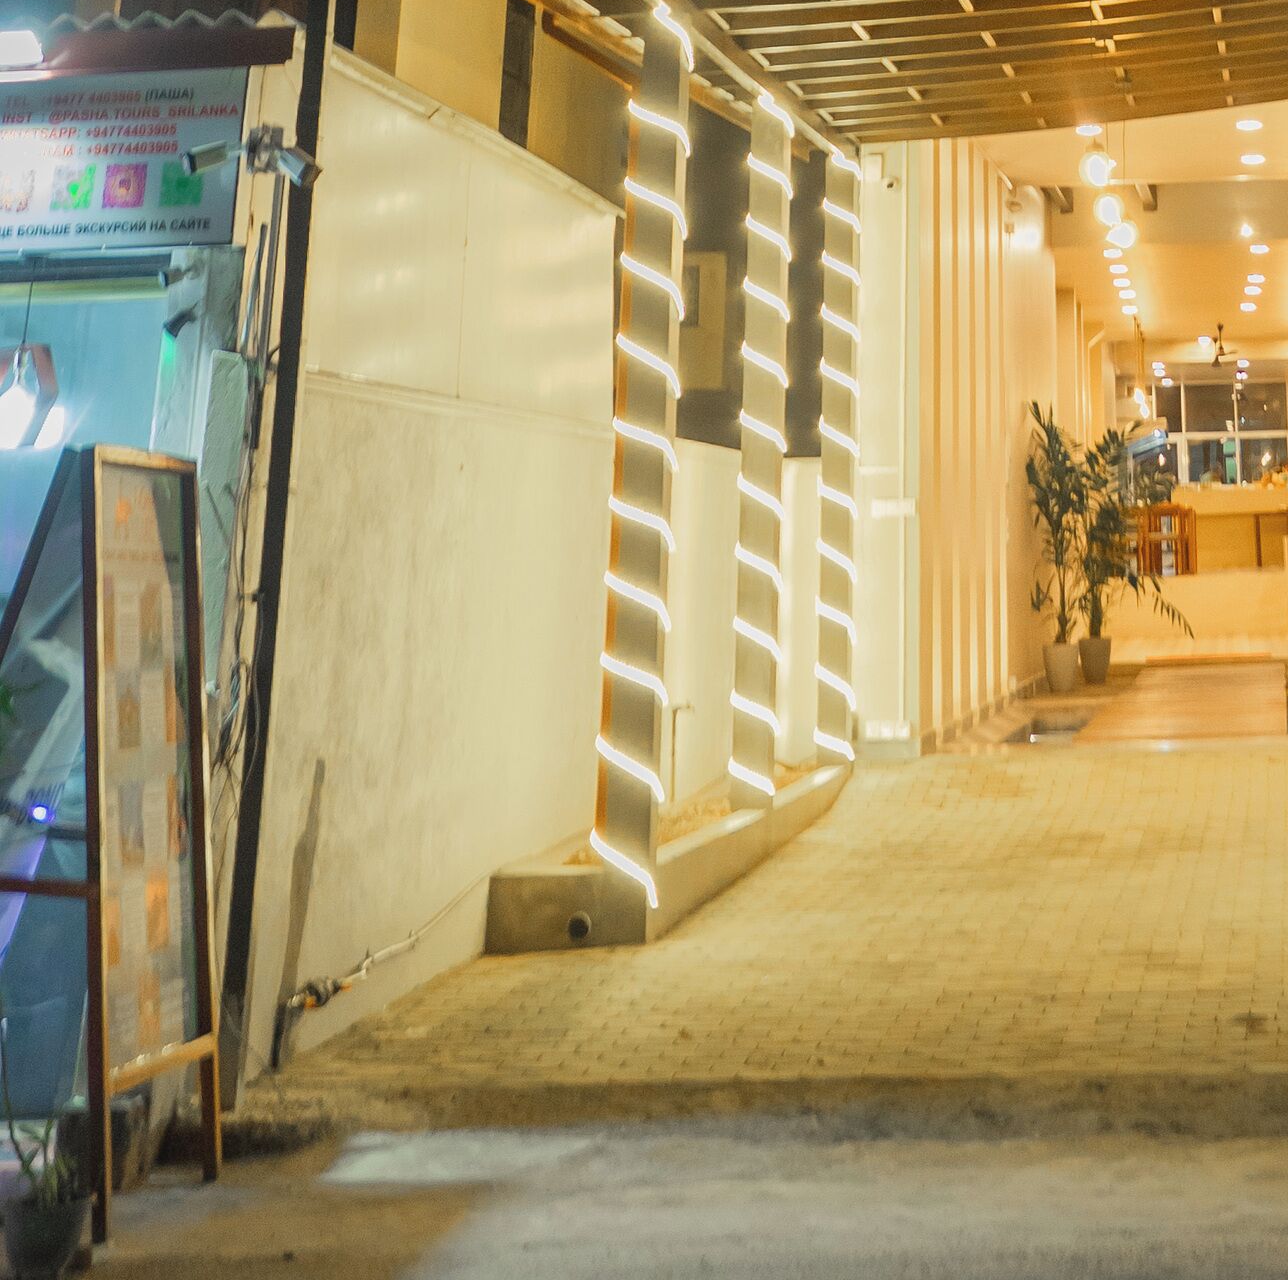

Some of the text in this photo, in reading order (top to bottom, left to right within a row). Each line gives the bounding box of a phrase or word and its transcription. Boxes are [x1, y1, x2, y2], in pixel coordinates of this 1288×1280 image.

[145, 88, 194, 101] (ПАША)
[3, 113, 32, 124] INST
[17, 222, 71, 237] БОЛЬШЕ
[75, 220, 147, 234] ЭКСКУРСИЙ
[150, 220, 167, 233] НА
